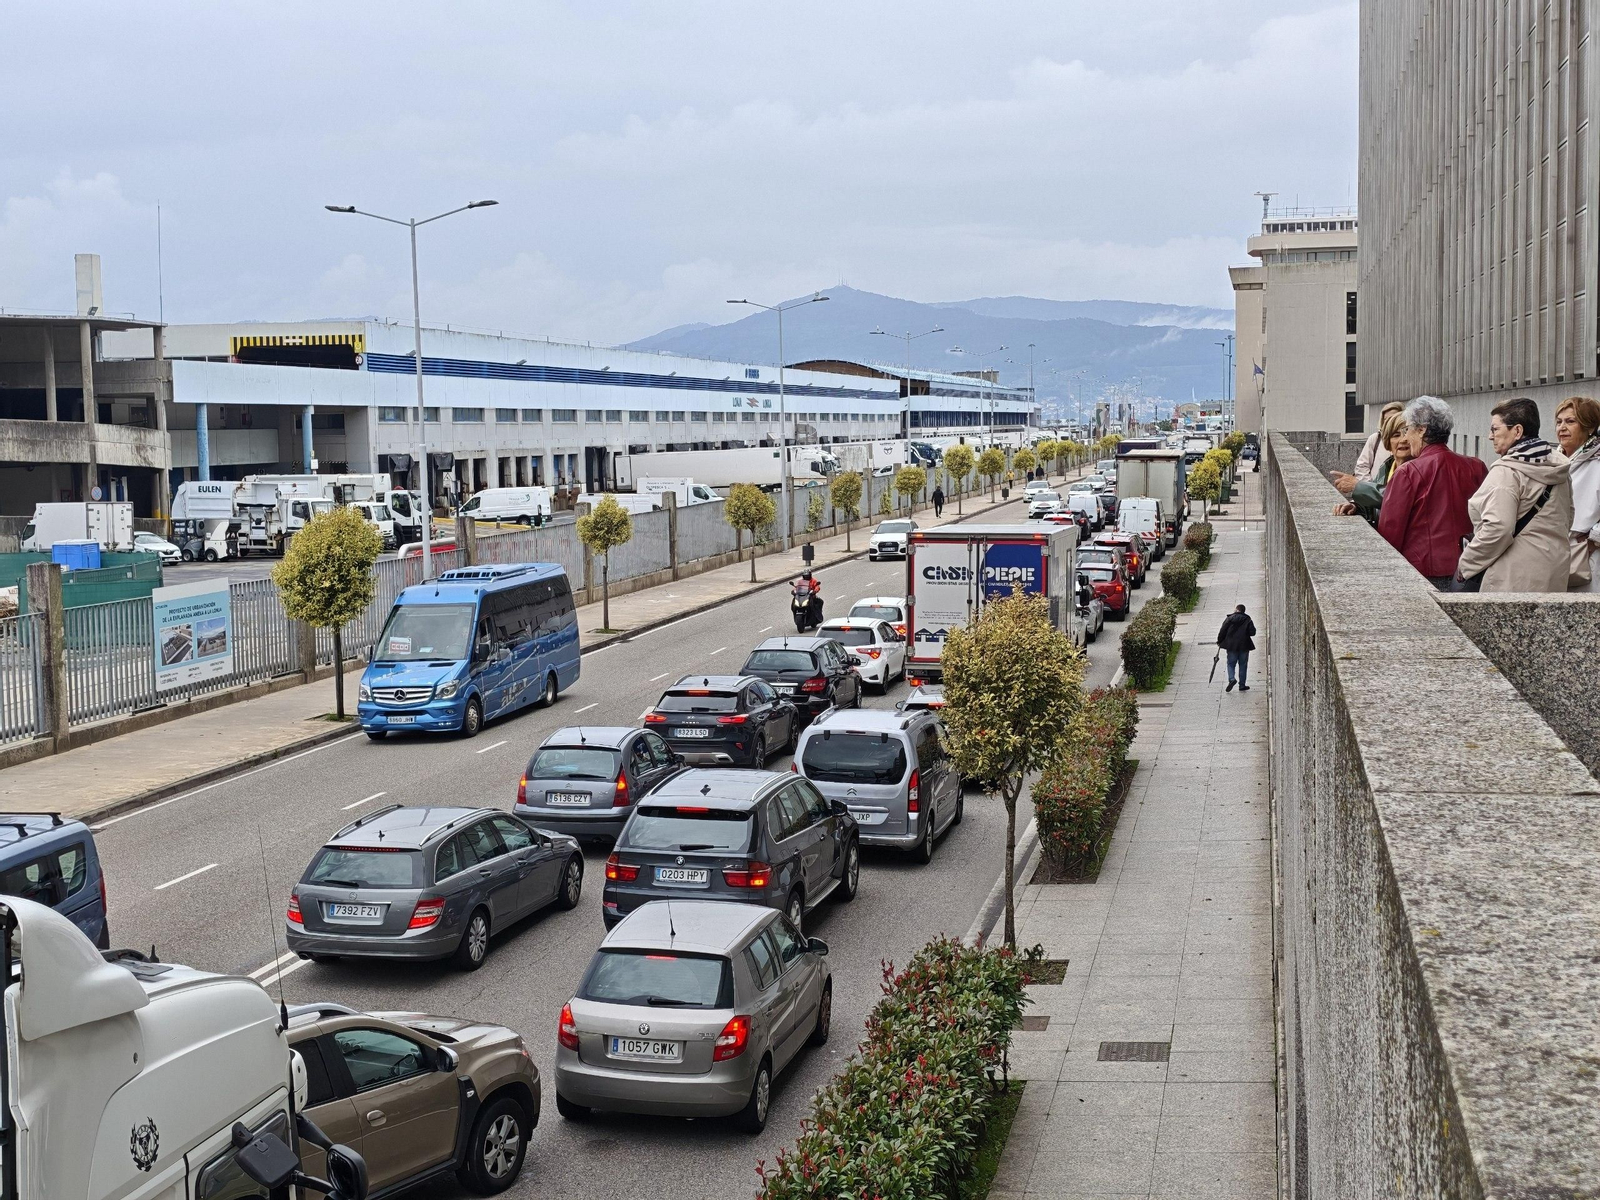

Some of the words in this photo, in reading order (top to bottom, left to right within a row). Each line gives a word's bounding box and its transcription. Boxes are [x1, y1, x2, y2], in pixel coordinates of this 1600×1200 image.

[982, 566, 1035, 581] PEPE
[168, 606, 187, 615] PROYECTO
[553, 794, 571, 802] 6136
[574, 794, 588, 803] CZY
[856, 813, 871, 821] JXP
[661, 869, 685, 880] 0203
[687, 871, 706, 881] HPY
[336, 905, 358, 916] 7392
[360, 906, 379, 916] FZV
[622, 1040, 650, 1053] 1057
[653, 1042, 675, 1055] GWK
